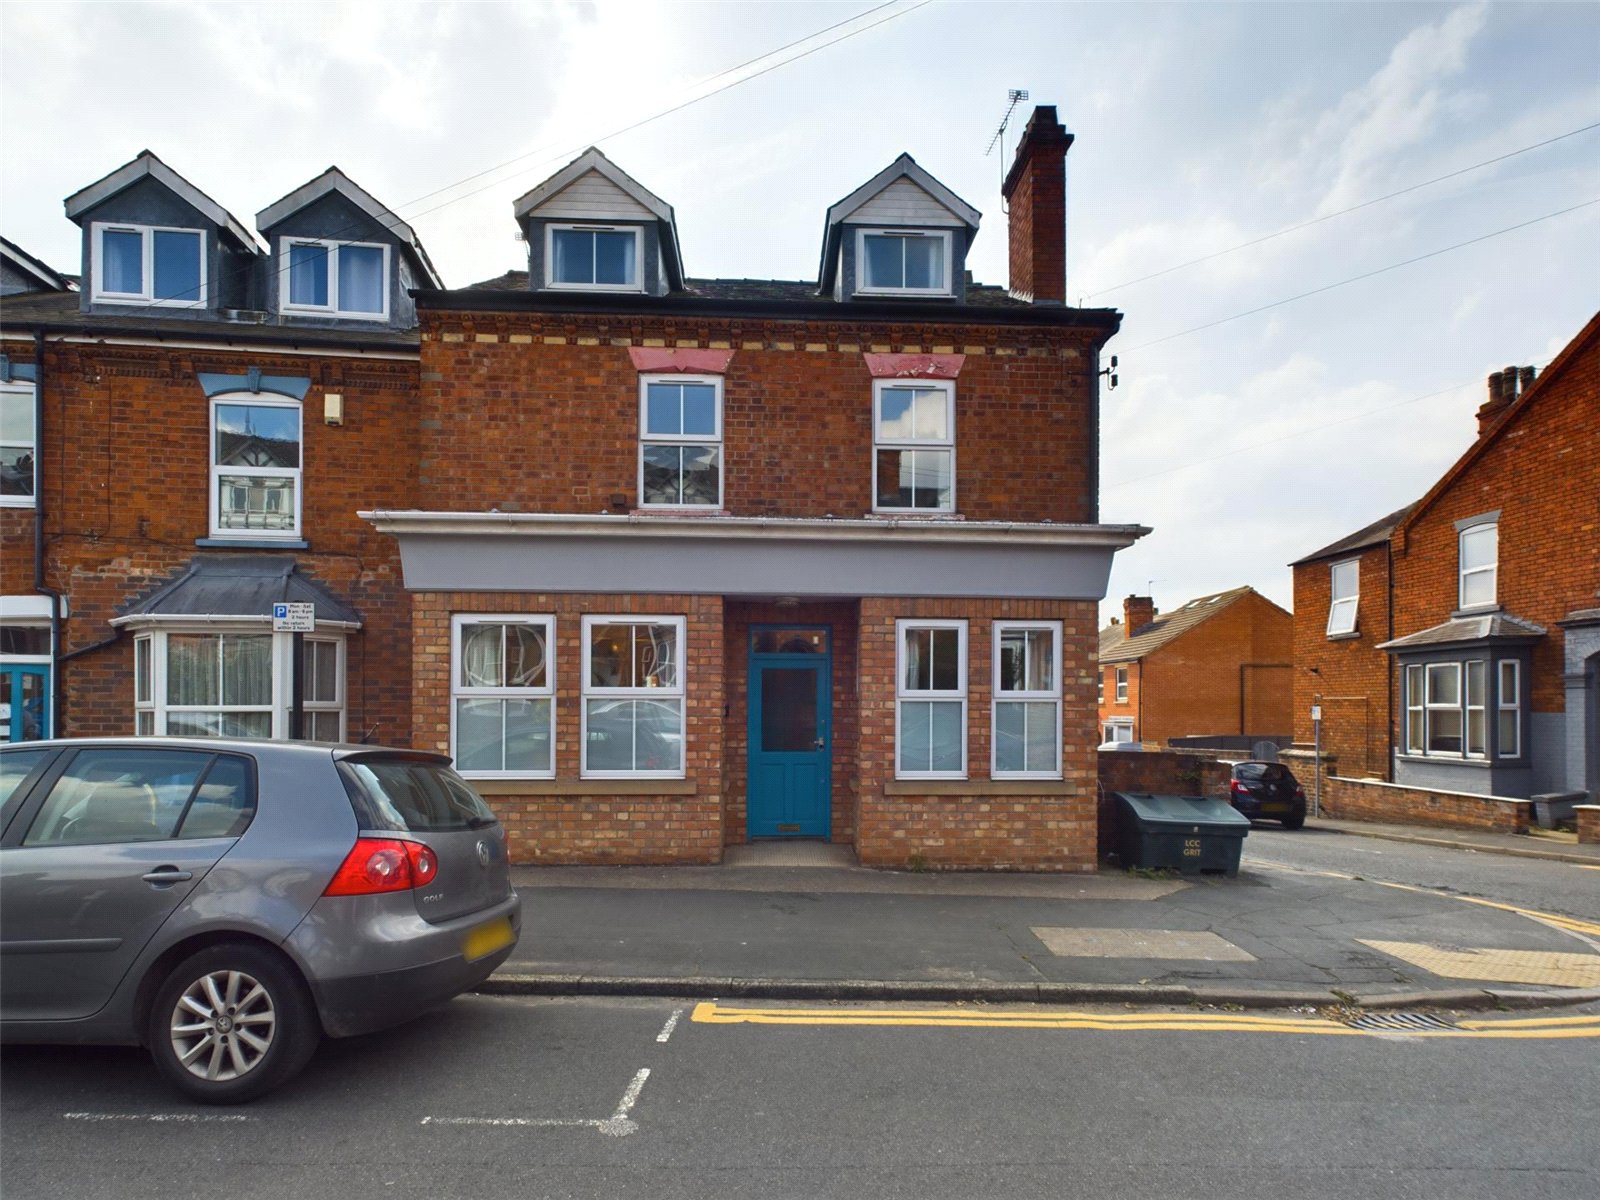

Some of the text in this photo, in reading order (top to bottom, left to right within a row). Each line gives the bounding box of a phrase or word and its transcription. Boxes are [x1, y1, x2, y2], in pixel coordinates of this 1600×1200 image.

[277, 606, 285, 616] P
[1183, 848, 1202, 856] GRIT
[423, 894, 444, 904] GOLF
